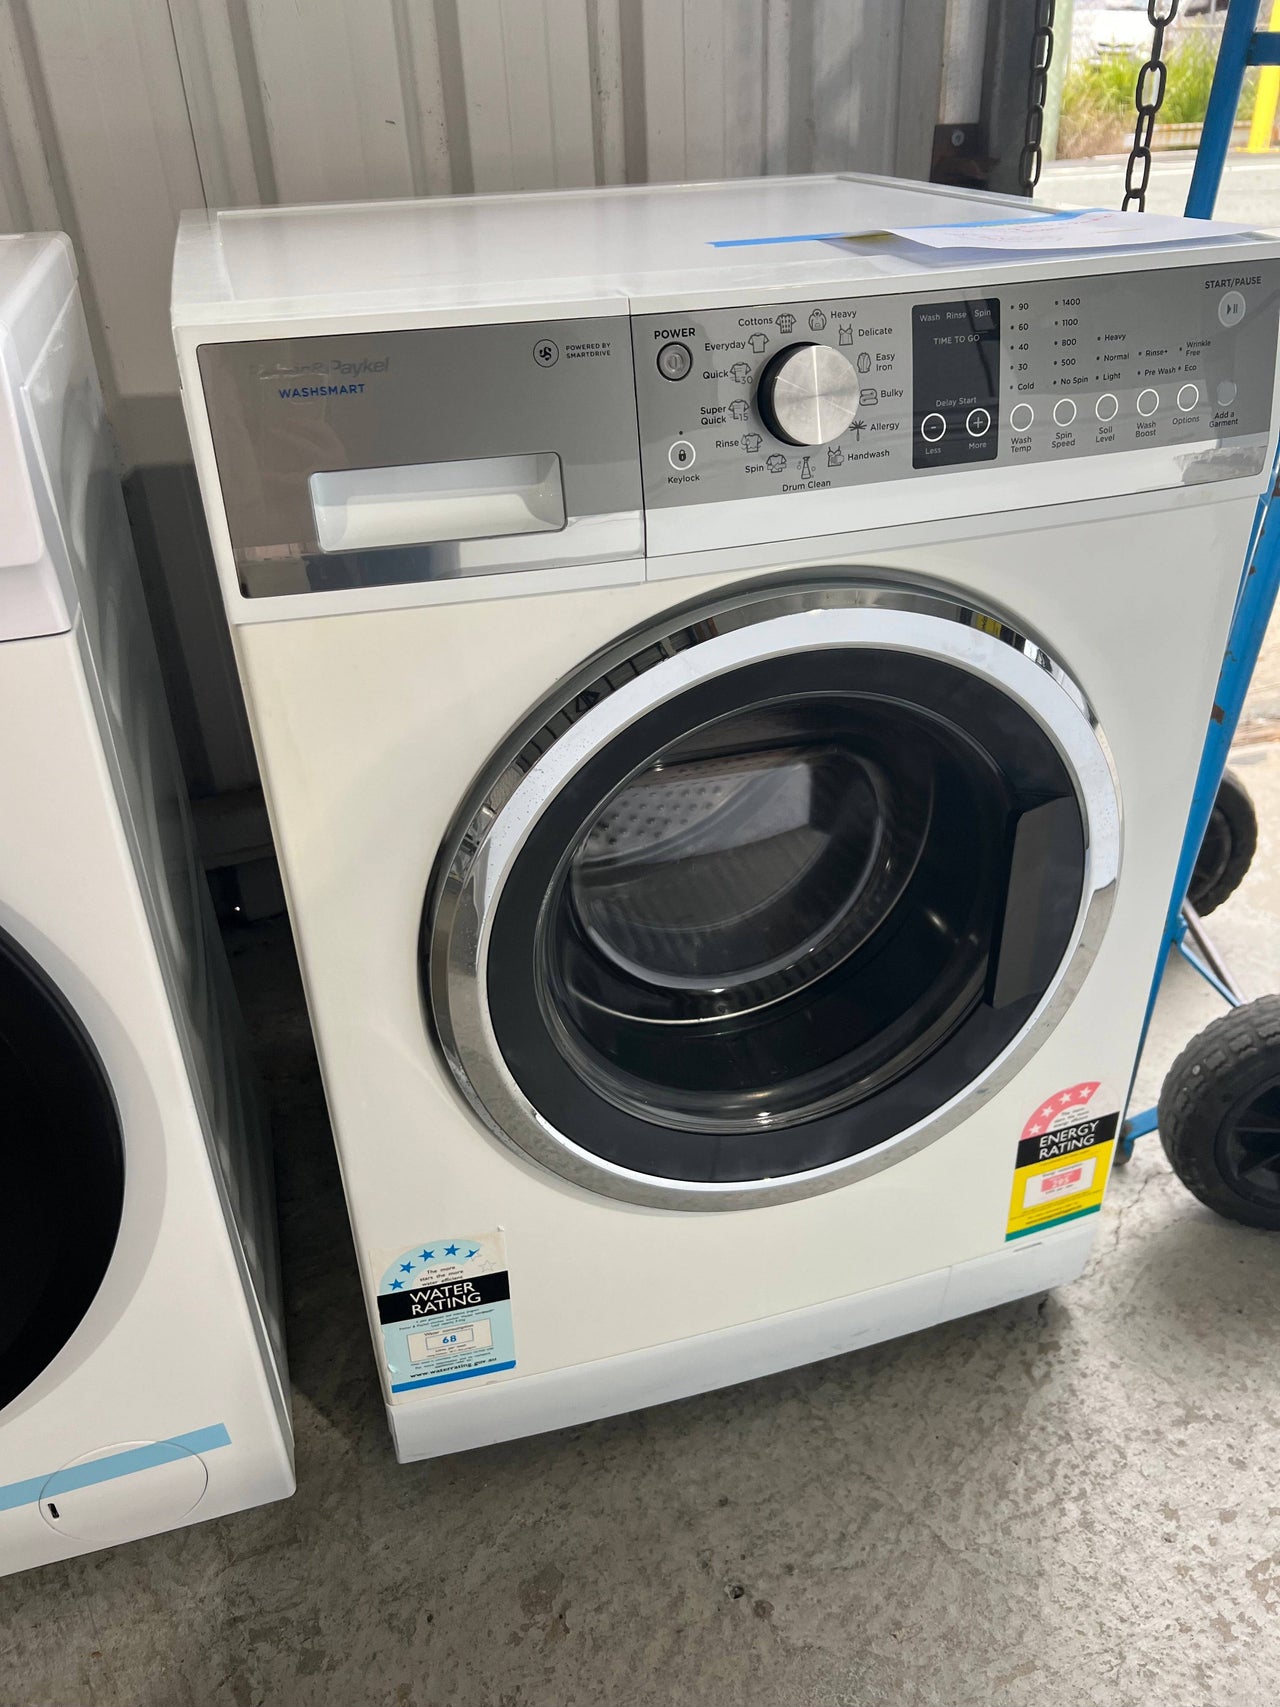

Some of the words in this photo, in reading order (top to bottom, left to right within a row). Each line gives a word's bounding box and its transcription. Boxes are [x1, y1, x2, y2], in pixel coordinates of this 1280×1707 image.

[1205, 276, 1262, 289] START/PAUSE
[1062, 298, 1081, 306] 1400
[830, 310, 857, 319] Heavy
[920, 313, 940, 322] Wash
[946, 312, 967, 320] Rinse
[974, 309, 991, 318] Spin
[738, 317, 773, 327] Cottons
[1062, 318, 1079, 326] 1100
[858, 326, 893, 337] Delicate
[1018, 323, 1029, 331] 60
[654, 327, 696, 339] POWER
[933, 337, 952, 345] TIME
[954, 335, 966, 343] TO
[967, 334, 980, 342] GO
[1061, 338, 1077, 346] 800
[1104, 334, 1126, 342] Heavy
[565, 343, 600, 351] POWERED
[705, 340, 746, 352] Everyday
[1018, 343, 1029, 351] 40
[1186, 340, 1211, 348] Wrinkle
[566, 350, 611, 359] SMARTDRIVE
[875, 353, 895, 362] Easy
[1103, 353, 1129, 361] Normal
[1061, 358, 1076, 366] 500
[876, 363, 893, 372] Iron
[1017, 363, 1028, 371] 30
[1158, 367, 1176, 375] Wash
[1184, 364, 1197, 372] Eco
[703, 369, 729, 380] Quick
[1103, 372, 1121, 381] Light
[740, 375, 753, 384] 30
[1073, 376, 1089, 384] Spin
[278, 383, 365, 398] WASHSMART
[1017, 382, 1035, 391] Cold
[880, 389, 904, 398] Bulky
[935, 399, 957, 407] Delay
[958, 397, 977, 405] Start
[700, 406, 726, 416] Super
[1214, 411, 1229, 419] Add
[700, 415, 727, 425] Quick
[739, 412, 749, 421] 15
[1172, 416, 1200, 425] Options
[870, 421, 900, 432] Allergy
[1136, 421, 1157, 429] Wash
[1209, 418, 1238, 428] Garment
[1098, 426, 1113, 434] Soil
[1136, 429, 1156, 437] Boost
[1011, 436, 1032, 445] Wash
[1055, 432, 1073, 440] Spin
[1096, 434, 1115, 443] Level
[715, 439, 740, 448] Rinse
[1051, 439, 1075, 449] Speed
[1011, 445, 1032, 453] Temp
[847, 449, 890, 461] Handwash
[745, 464, 764, 474] Spin
[667, 474, 700, 485] Keylock
[782, 482, 805, 492] Drum
[807, 479, 831, 489] Clean
[1040, 1120, 1100, 1147] ENERGY
[1039, 1133, 1095, 1159] RATING
[410, 1282, 475, 1301] WATER
[411, 1292, 481, 1315] RATING
[442, 1335, 457, 1344] 68
